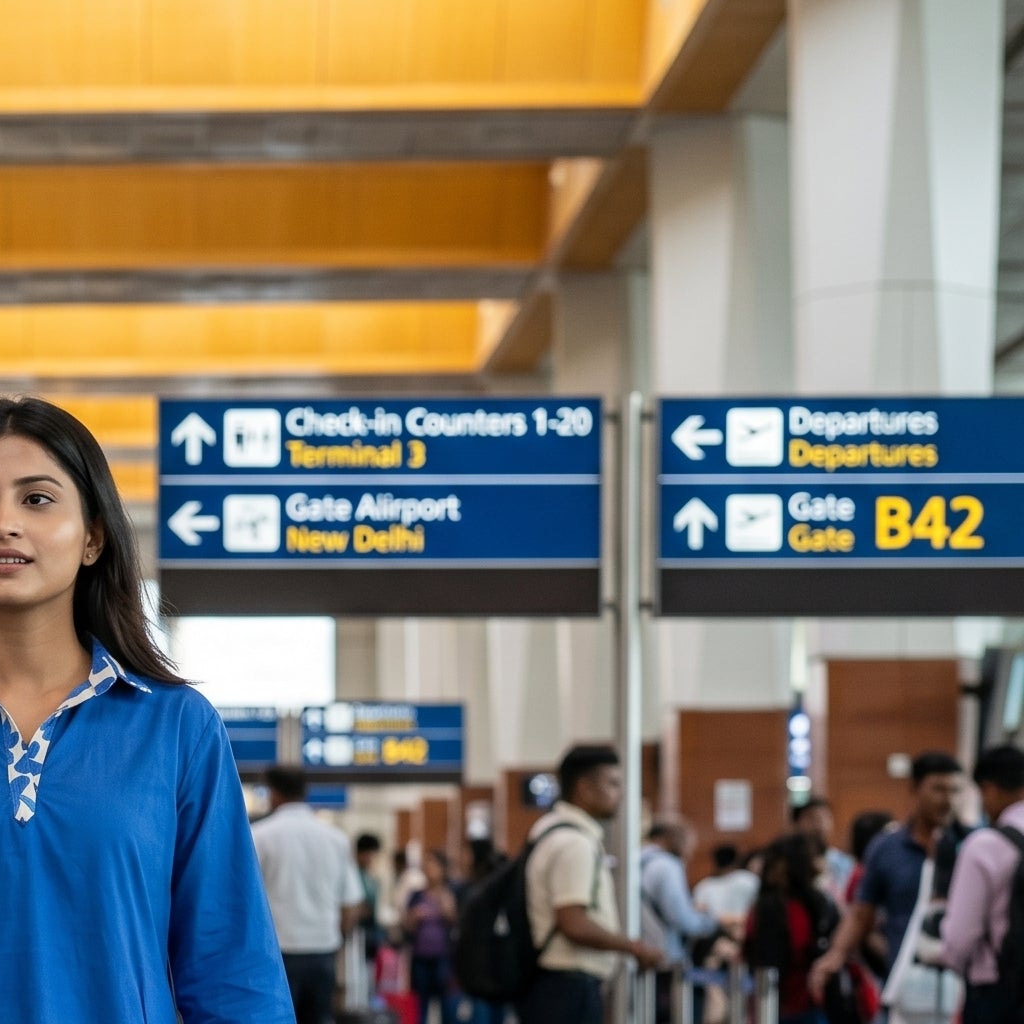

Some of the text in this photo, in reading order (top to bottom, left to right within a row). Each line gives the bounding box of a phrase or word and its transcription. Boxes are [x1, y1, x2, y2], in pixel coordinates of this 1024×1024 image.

[286, 406, 593, 437] Check-in Counters 1-20
[788, 406, 939, 440] Departures
[285, 439, 426, 469] Terminal 3
[788, 438, 939, 471] Departures
[286, 492, 353, 522] Gate
[788, 492, 855, 522] Gate
[788, 523, 855, 552] Gate
[875, 495, 985, 550] B42
[286, 524, 424, 553] New Delhi
